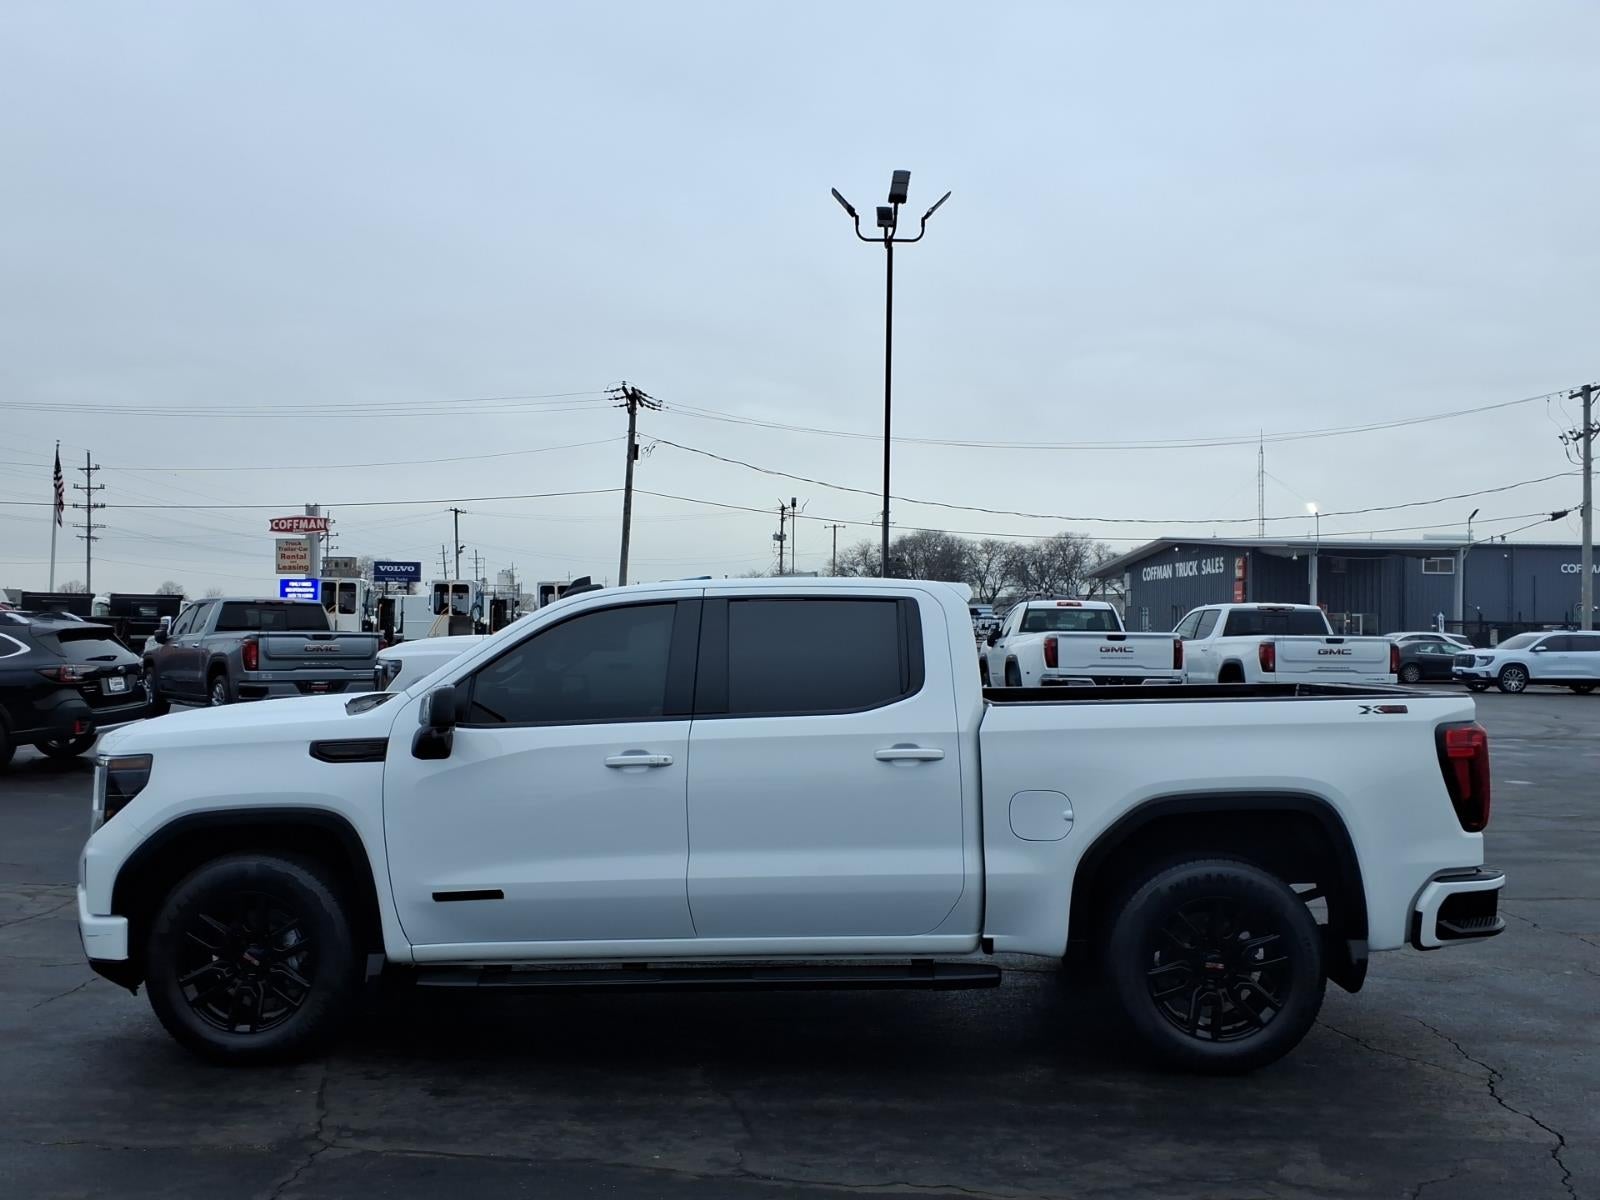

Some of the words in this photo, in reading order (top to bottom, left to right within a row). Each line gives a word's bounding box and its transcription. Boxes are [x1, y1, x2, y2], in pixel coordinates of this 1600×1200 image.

[272, 519, 325, 529] COFFMAN
[277, 564, 309, 572] Leasing
[1142, 564, 1173, 581] COFFMAN
[1175, 560, 1198, 577] TRUCK
[1201, 556, 1224, 575] SALES
[304, 644, 340, 652] GMC
